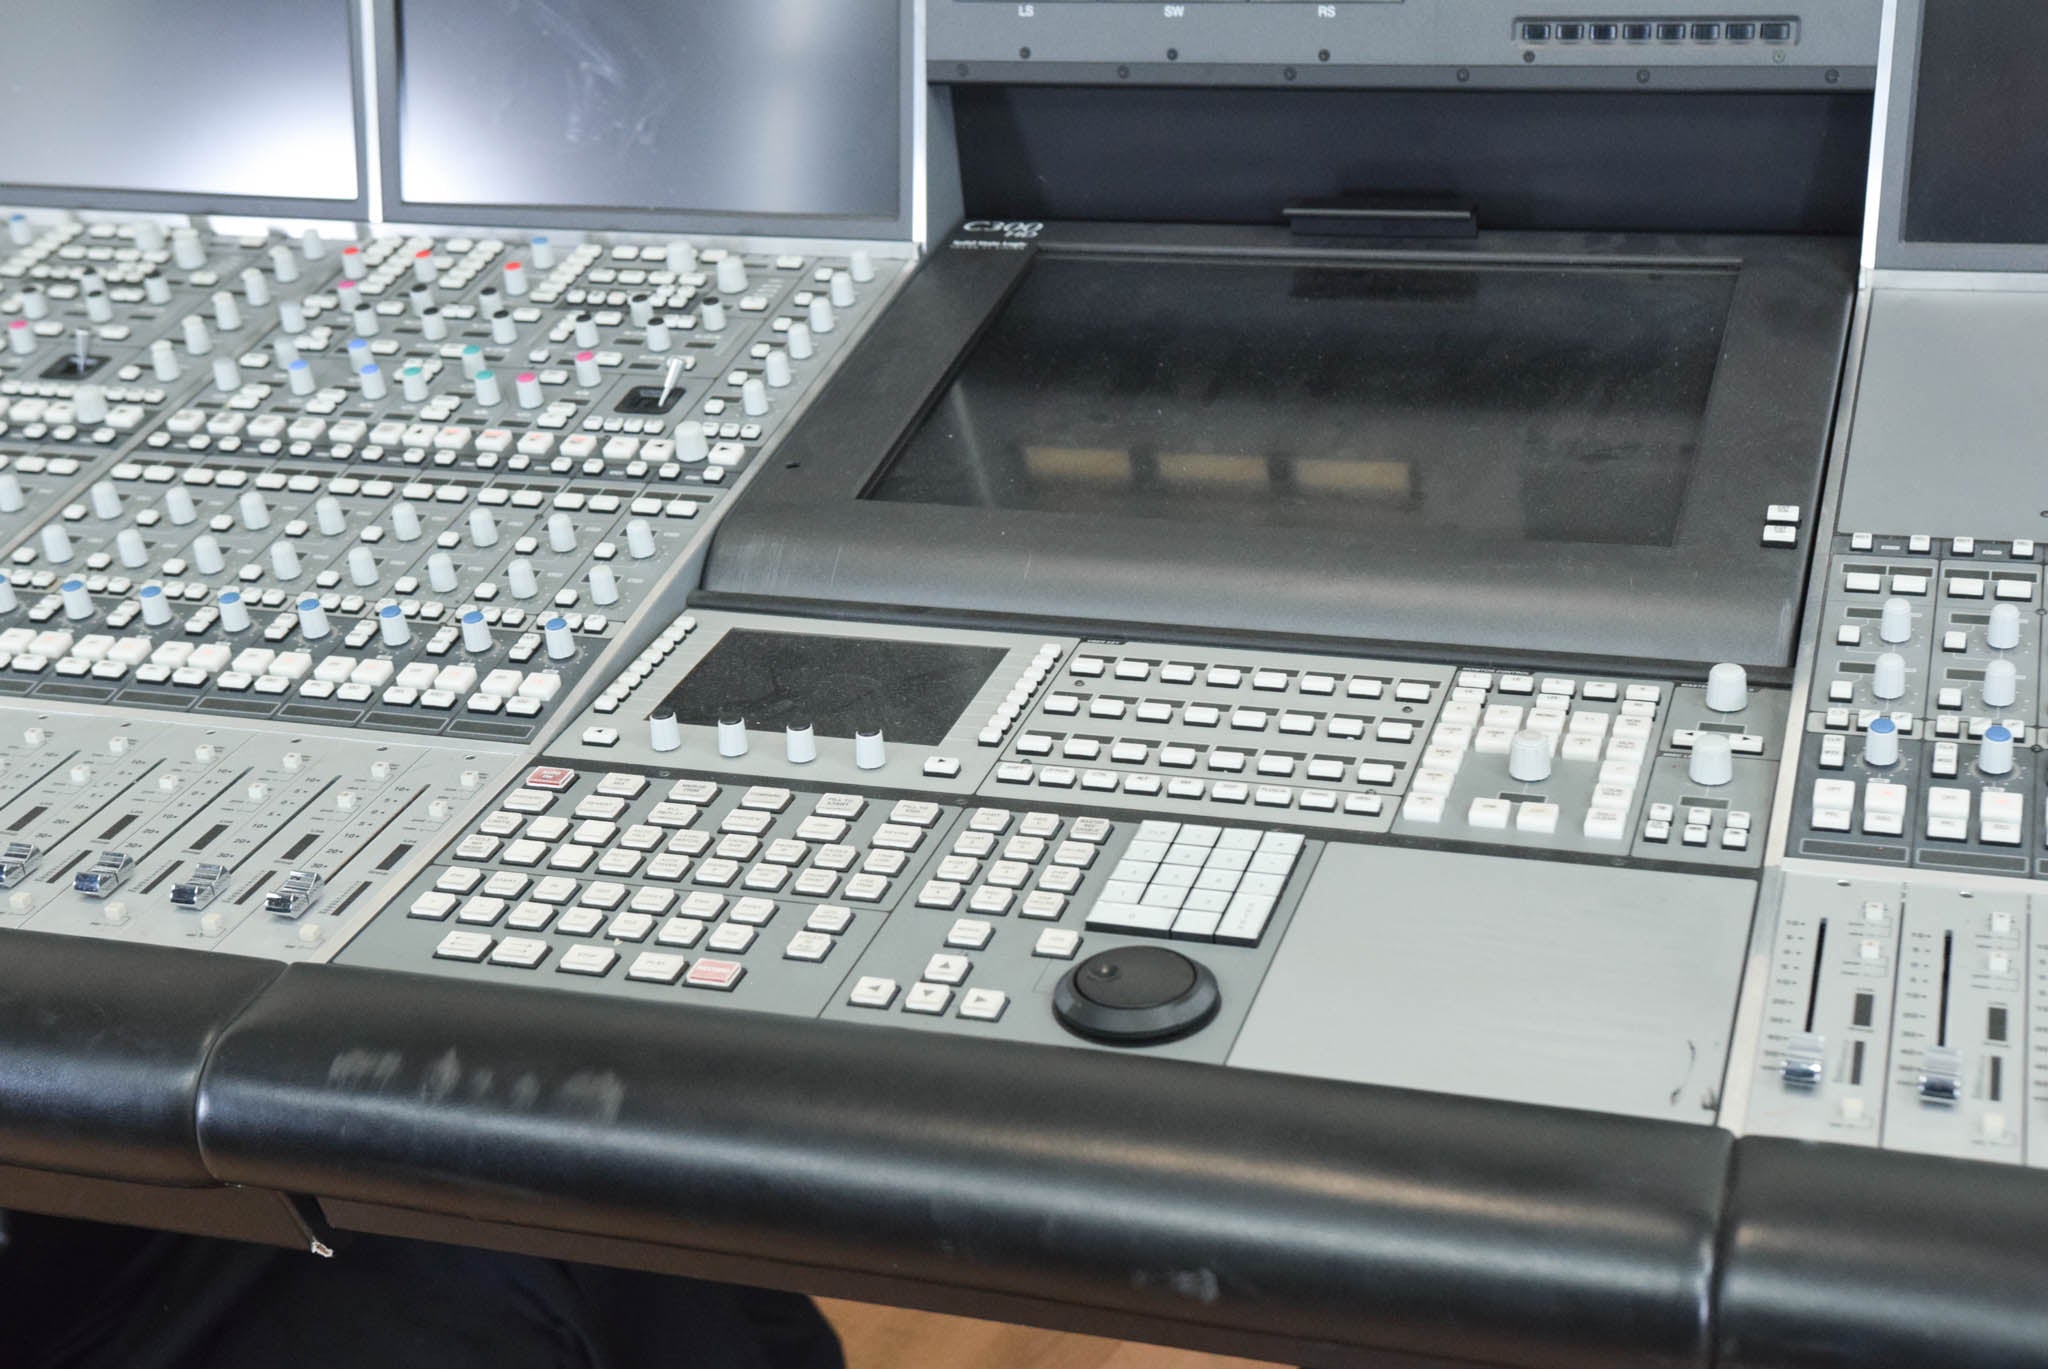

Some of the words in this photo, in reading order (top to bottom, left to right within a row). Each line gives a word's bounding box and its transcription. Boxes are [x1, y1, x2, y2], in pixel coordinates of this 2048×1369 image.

[1018, 5, 1035, 17] LS
[1163, 5, 1185, 18] SW
[1317, 5, 1336, 18] RS
[963, 220, 1044, 232] C300
